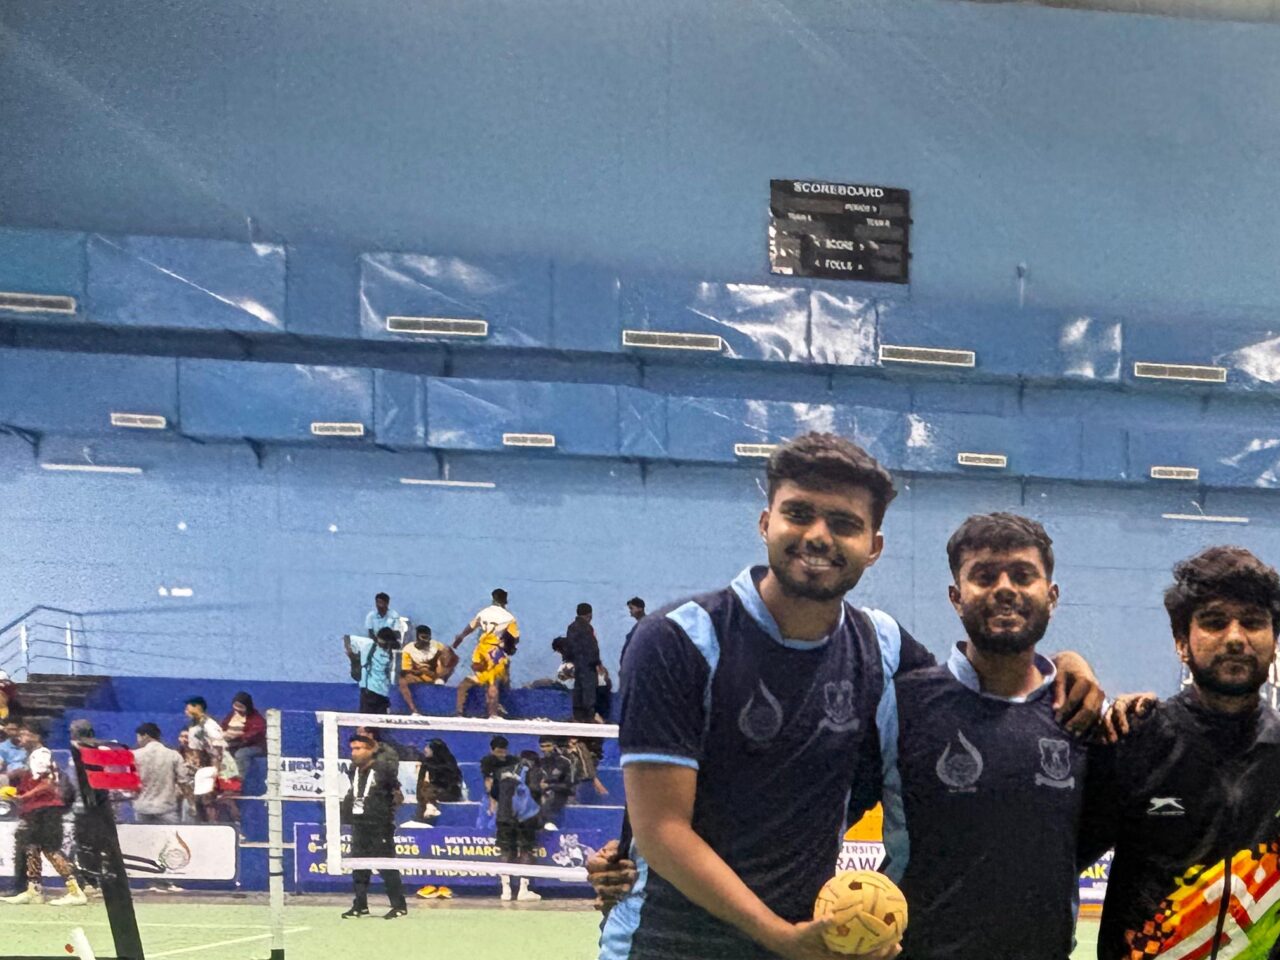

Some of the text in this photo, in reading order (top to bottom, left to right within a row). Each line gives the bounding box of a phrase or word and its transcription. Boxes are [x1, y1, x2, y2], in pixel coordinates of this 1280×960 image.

[793, 182, 885, 198] SCOREBOARD
[394, 844, 420, 856] 026
[462, 845, 501, 857] MARC
